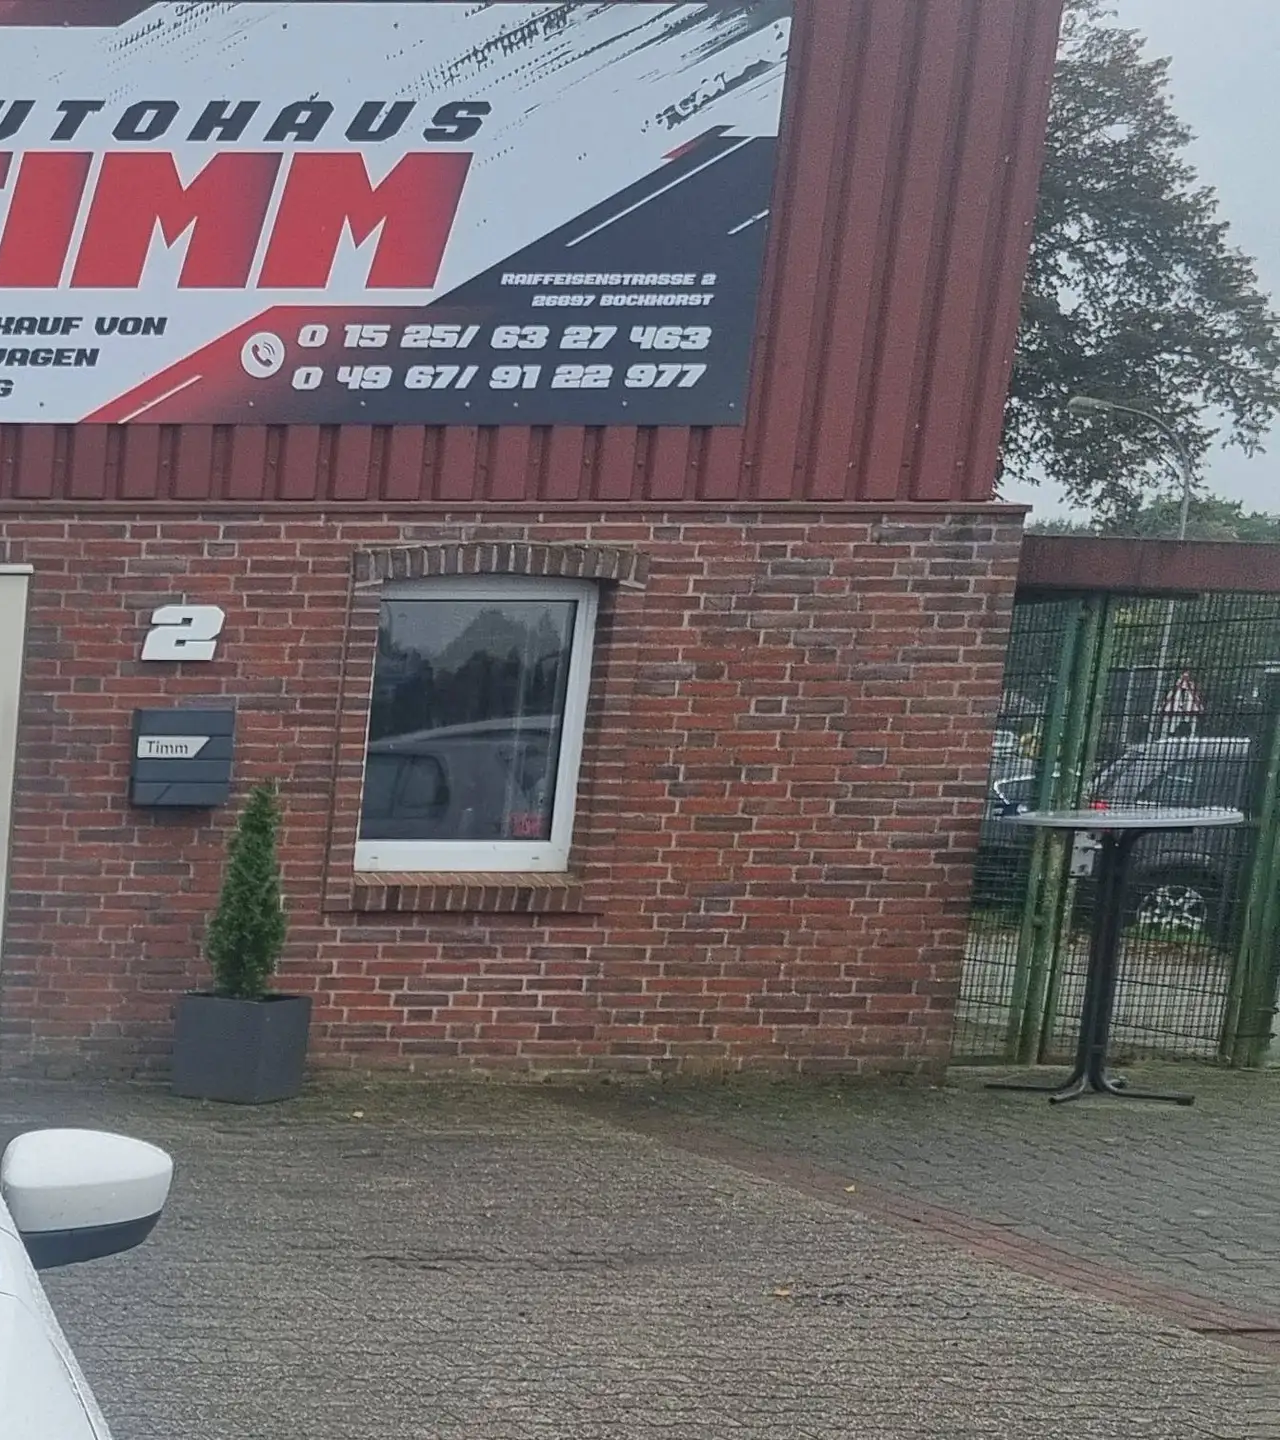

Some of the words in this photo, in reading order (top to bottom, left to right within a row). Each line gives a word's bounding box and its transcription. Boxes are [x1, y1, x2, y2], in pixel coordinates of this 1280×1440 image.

[500, 272, 696, 286] RAIFFEISENSTRASSE
[700, 273, 717, 286] 2
[599, 293, 715, 307] BOCKHORST
[94, 316, 169, 337] VON
[297, 324, 330, 349] 0
[343, 324, 392, 349] 15
[399, 324, 482, 350] 25/
[489, 325, 551, 350] 63
[558, 325, 619, 350] 27
[628, 325, 713, 350] 463
[291, 365, 325, 391] 0
[336, 364, 394, 390] 49
[403, 364, 481, 390] 67/
[488, 364, 543, 390] 91
[550, 363, 614, 389] 22
[623, 363, 708, 389] 977
[141, 604, 226, 661] 2
[145, 739, 189, 756] Timm
